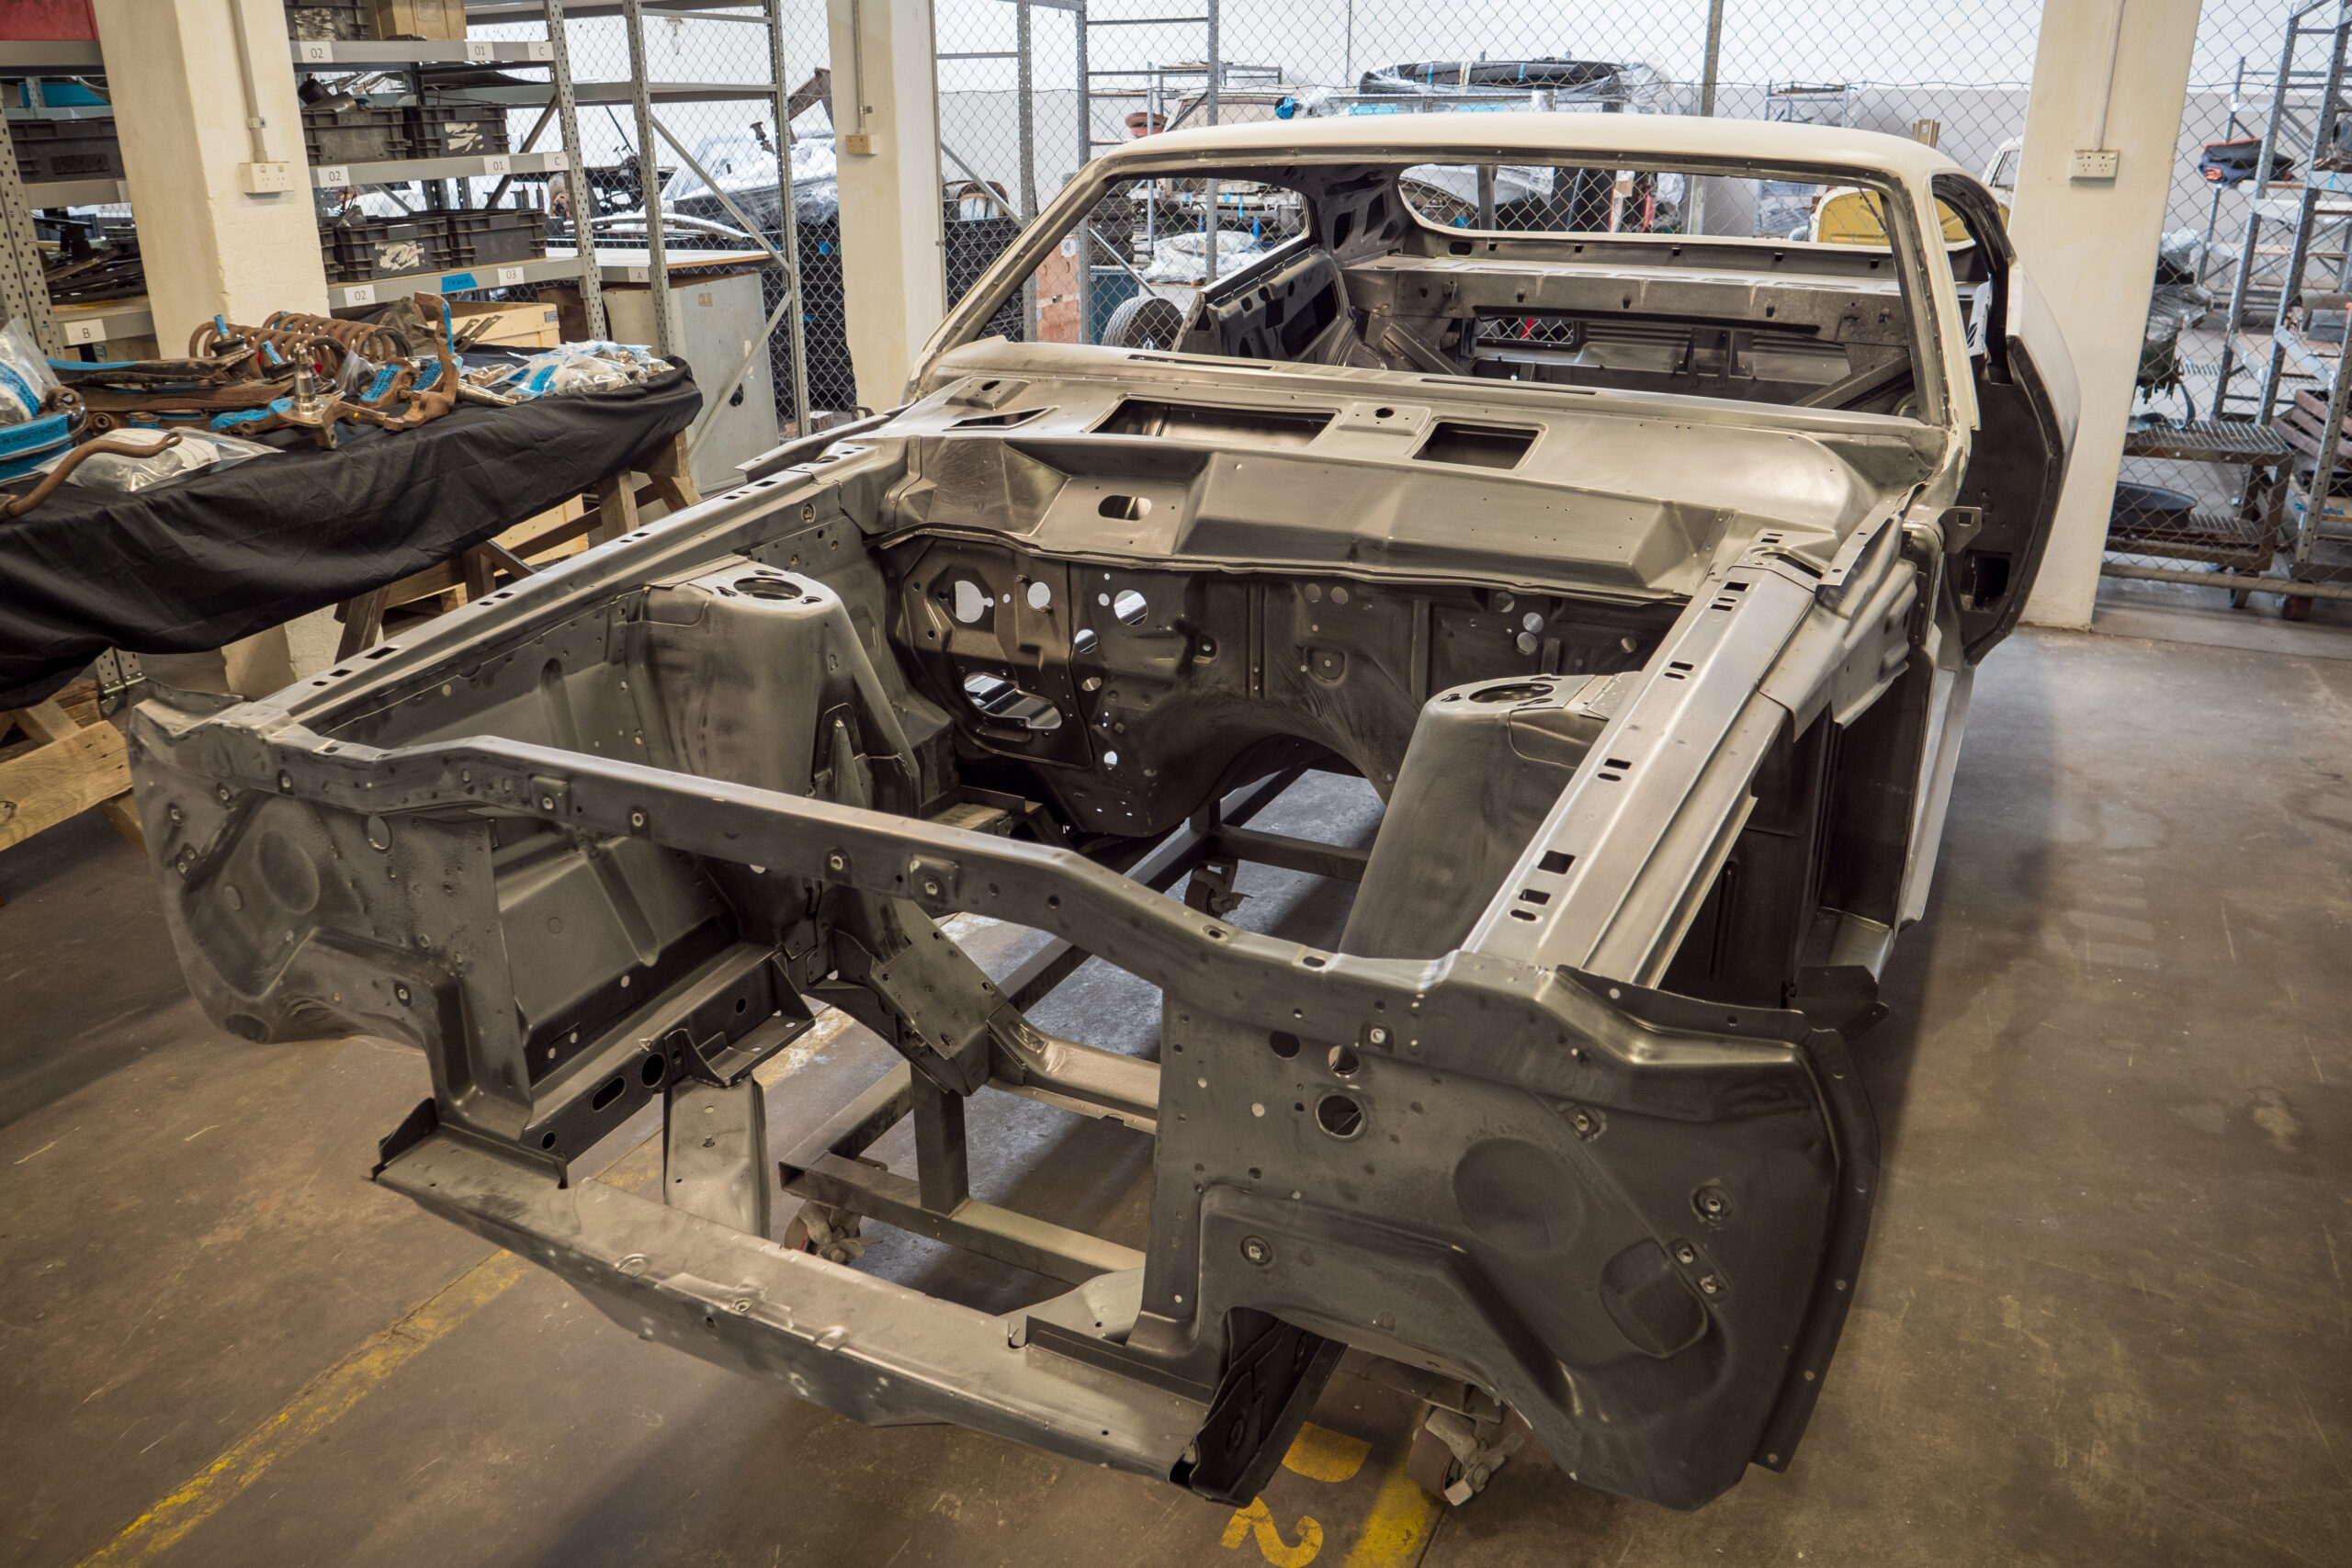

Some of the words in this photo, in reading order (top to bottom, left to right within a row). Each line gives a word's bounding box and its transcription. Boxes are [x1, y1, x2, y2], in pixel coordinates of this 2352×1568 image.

[311, 48, 323, 59] 02
[475, 46, 486, 56] 01
[538, 47, 545, 56] C
[554, 156, 560, 165] C
[492, 161, 504, 171] 01
[328, 171, 342, 182] 02
[506, 270, 517, 279] 03
[637, 271, 643, 280] A
[355, 290, 367, 300] 02
[82, 328, 91, 339] B
